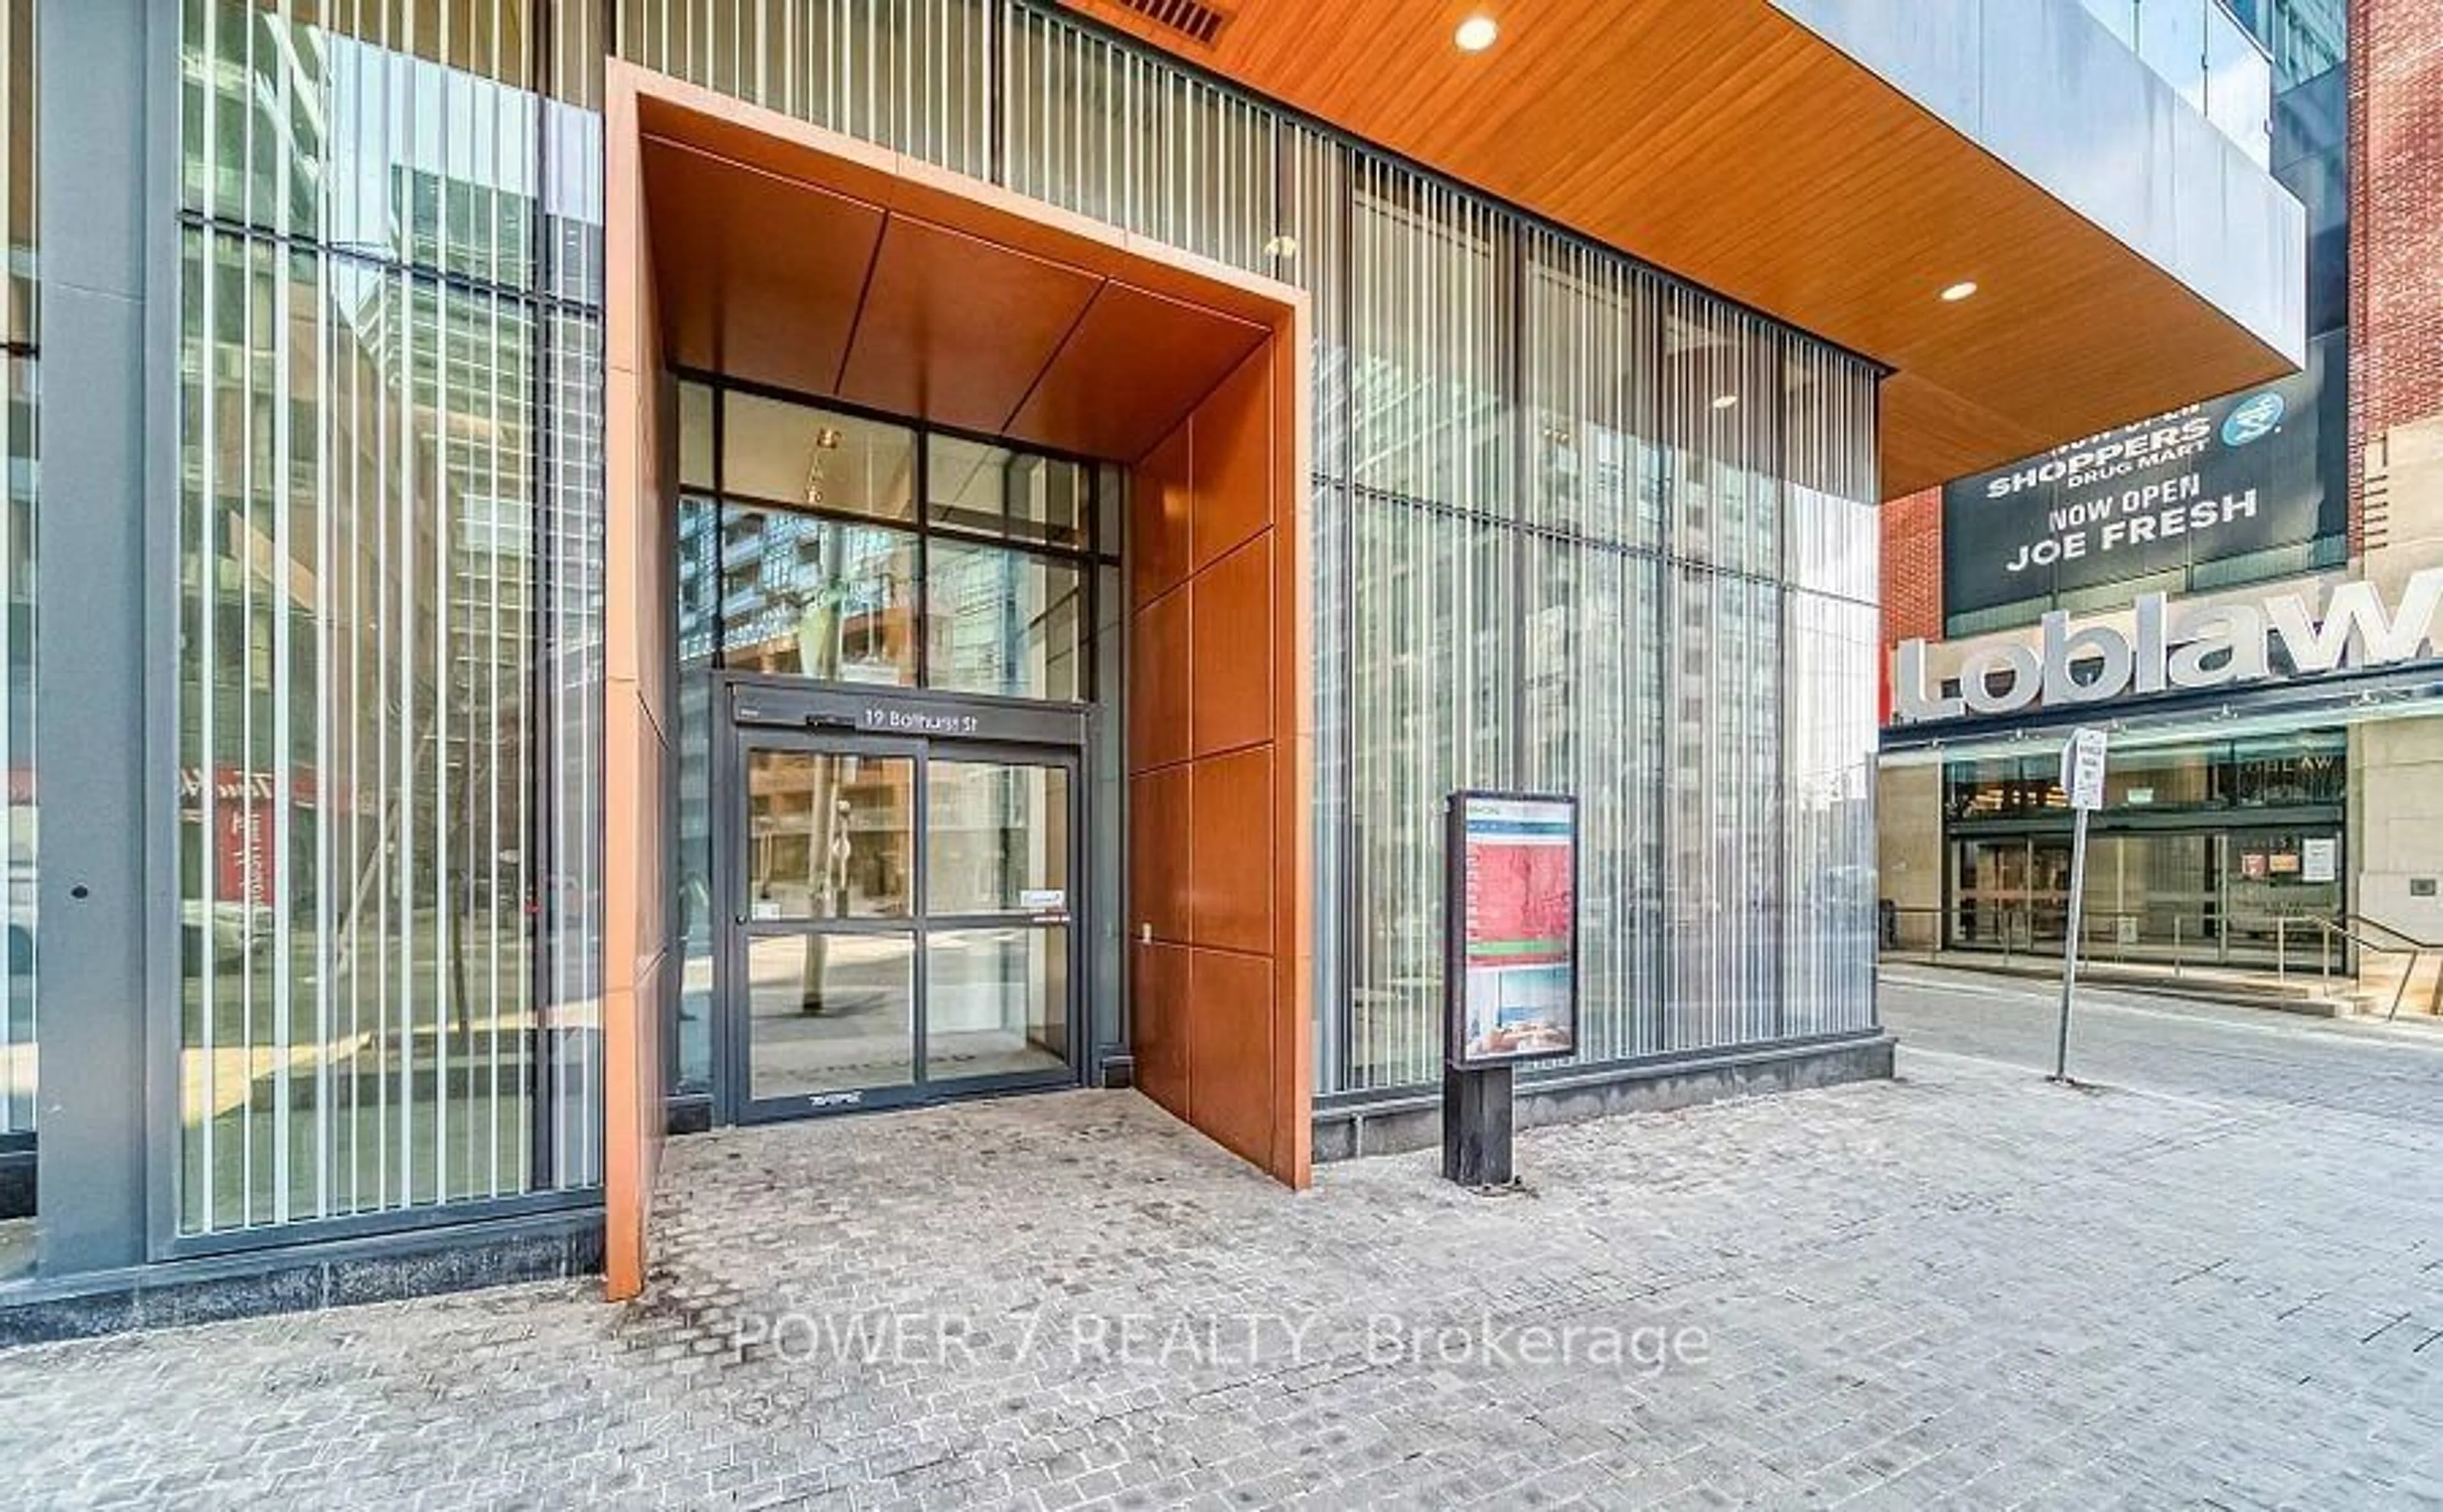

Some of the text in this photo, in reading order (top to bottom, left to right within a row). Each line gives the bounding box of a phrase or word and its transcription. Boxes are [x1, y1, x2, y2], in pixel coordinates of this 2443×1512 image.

[1986, 416, 2211, 498] SHOPPERS
[2068, 438, 2210, 489] DRUG MART
[2006, 488, 2258, 572] JOE FRESH
[2049, 474, 2201, 532] NOW OPEN
[1896, 565, 2443, 721] Loblaw
[865, 708, 884, 727] 19
[961, 715, 978, 732] St
